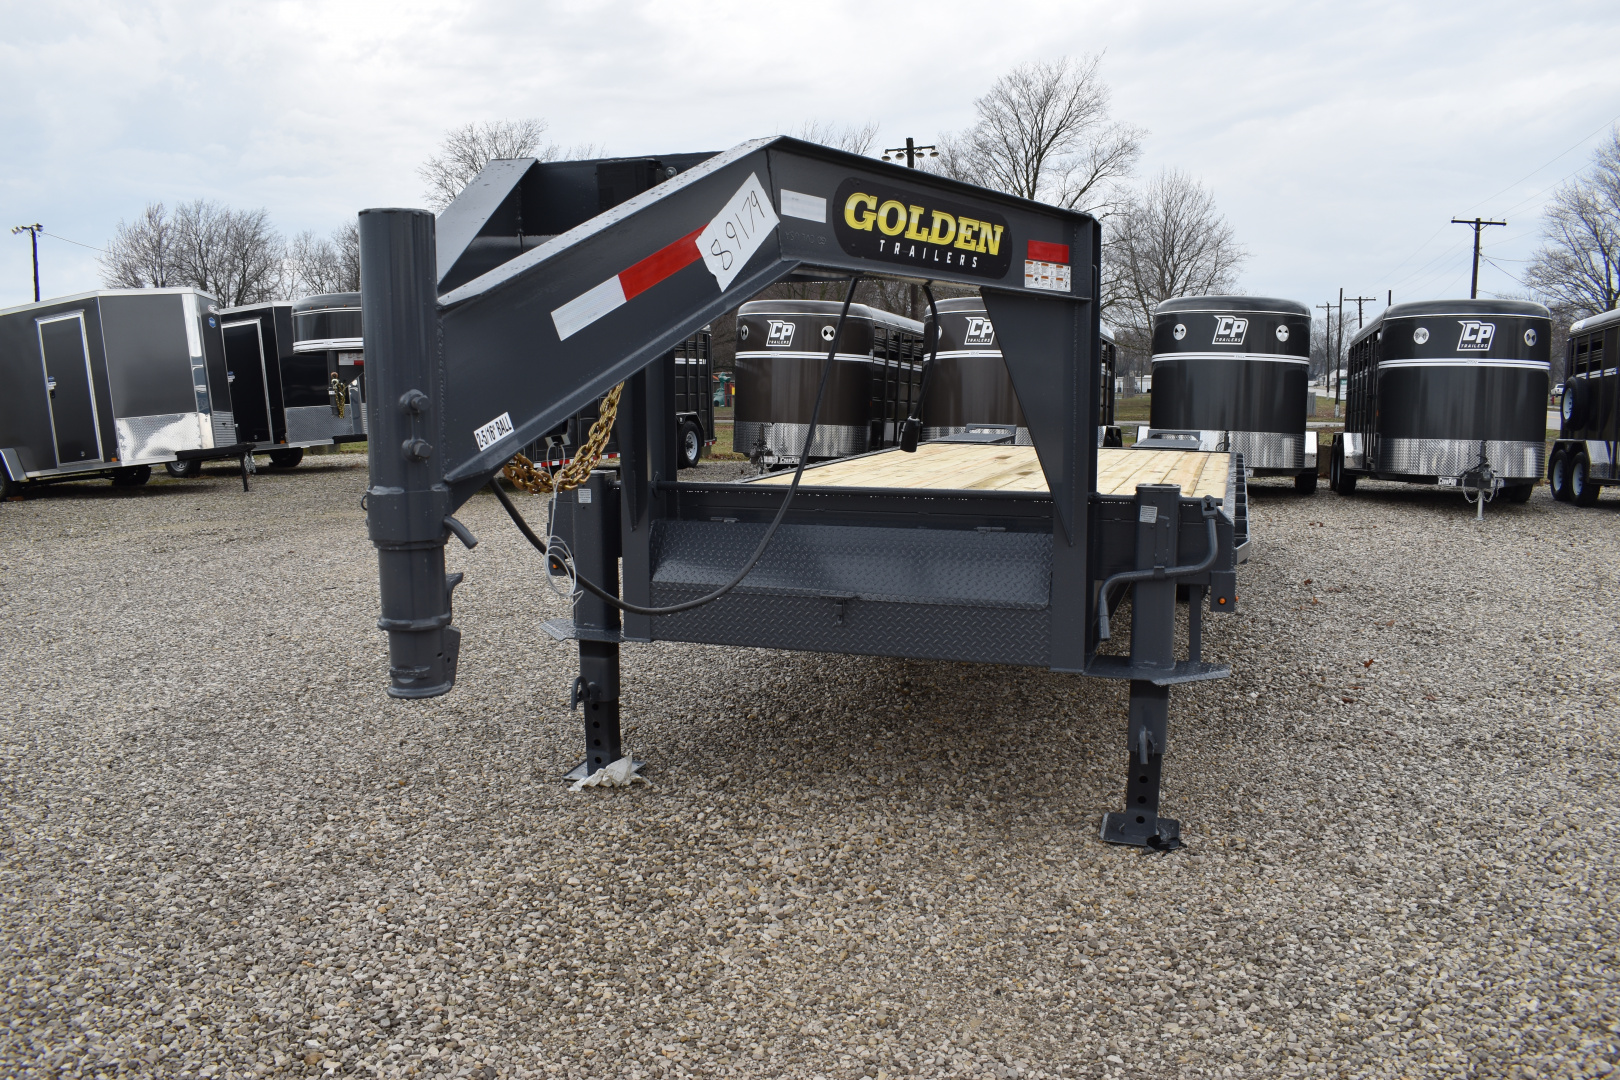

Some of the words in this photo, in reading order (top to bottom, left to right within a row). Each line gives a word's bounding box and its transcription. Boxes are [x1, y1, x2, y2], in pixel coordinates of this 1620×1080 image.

[710, 190, 765, 271] 89179
[844, 192, 1004, 256] GOLDEN
[879, 239, 978, 268] TRAILERS
[770, 323, 793, 340] CP
[969, 320, 993, 337] CP
[1218, 318, 1245, 337] CP
[1463, 323, 1492, 343] CP
[495, 416, 511, 436] BALL
